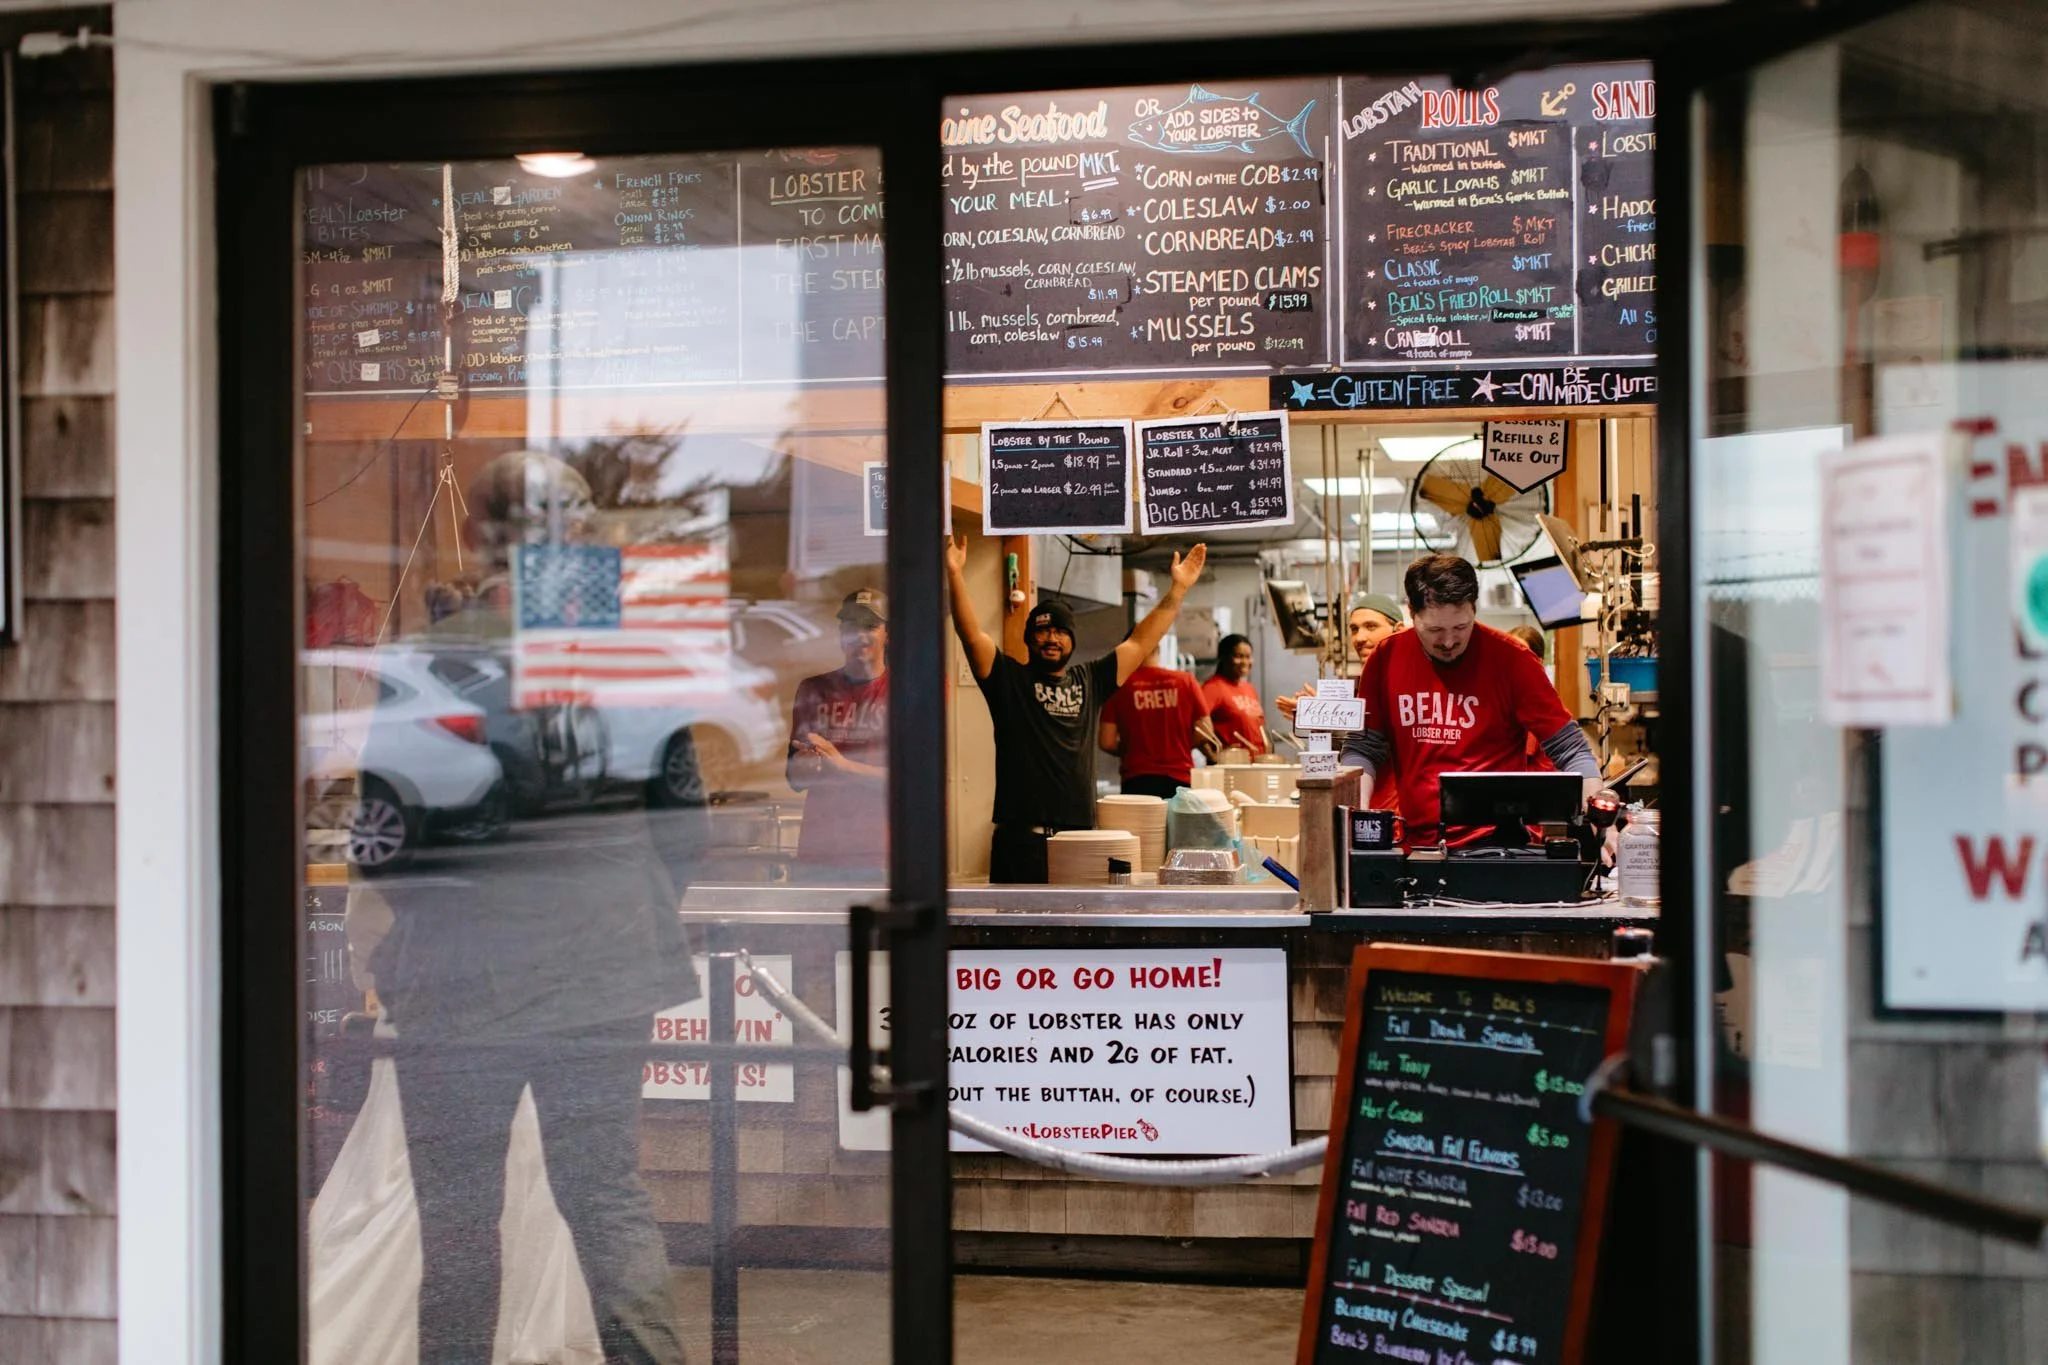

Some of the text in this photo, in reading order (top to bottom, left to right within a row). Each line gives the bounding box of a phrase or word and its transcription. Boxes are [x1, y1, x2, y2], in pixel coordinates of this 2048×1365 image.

[1134, 97, 1161, 117] OR
[1341, 79, 1424, 140] LOBSTAH
[1421, 86, 1501, 130] ROLLS
[997, 100, 1108, 144] Seafood
[1165, 112, 1195, 130] ADD
[1199, 109, 1240, 125] SIDES
[1166, 122, 1261, 143] YOUR LOBSTER
[1384, 129, 1549, 164] TRADITIONAL $MKT
[616, 172, 702, 189] FRENCH FRIES
[962, 157, 979, 190] by
[982, 152, 1014, 177] the
[1240, 163, 1280, 187] COB
[1280, 166, 1319, 183] $2.99
[769, 168, 868, 200] LOBSTER
[1387, 166, 1549, 201] GARLIC LOVAHS $MKT
[950, 193, 998, 215] YOUR
[1143, 195, 1311, 224] COLESLAW $2.00
[614, 208, 696, 226] ONION RINGS
[798, 207, 826, 226] TO
[1051, 226, 1126, 244] CORNBREAD
[1144, 227, 1315, 256] CORNBREAD $2.99
[1386, 220, 1475, 241] FIRECRACKER
[775, 234, 845, 261] FIRST
[1384, 252, 1553, 281] CLASSIC $MKT
[1024, 276, 1092, 290] CORNBREAD
[1143, 265, 1322, 294] STEAMED CLAMS
[1413, 277, 1441, 287] touch
[1442, 275, 1454, 286] of
[1188, 292, 1261, 317] per pound
[1387, 285, 1556, 317] BEAL'S FRIED ROLL $MKT
[1004, 329, 1061, 344] coleslaw
[1147, 313, 1255, 342] MUSSELS
[1514, 321, 1556, 342] $MKT
[1191, 343, 1214, 357] per
[1330, 366, 1601, 409] GLUTEN FREE CAN BE MADE
[990, 432, 1111, 447] LOBSTER THE POUND
[1148, 430, 1196, 442] LOBSTER
[1492, 430, 1559, 446] REFILLS &
[1063, 454, 1100, 470] $18.99
[1490, 448, 1561, 465] TAKE OUT
[1147, 467, 1193, 479] STANDARD
[1148, 487, 1182, 498] JUMBO
[1148, 500, 1222, 525] BIG BEAL
[1132, 687, 1179, 710] CREW
[1310, 715, 1348, 727] OPEN
[1398, 692, 1480, 729] BEAL'S
[1442, 728, 1462, 740] PIER
[956, 956, 1223, 991] BIG OR GO HOME!
[988, 1012, 1018, 1031] OF
[1027, 1011, 1123, 1031] LOBSTER
[1134, 1012, 1176, 1031] HAS
[1186, 1012, 1245, 1032] ONLY
[1049, 1039, 1234, 1065] AND 2G OF FAT.
[995, 1086, 1031, 1103] THE
[1129, 1086, 1156, 1104] OF
[1164, 1075, 1257, 1109] COURSE.)
